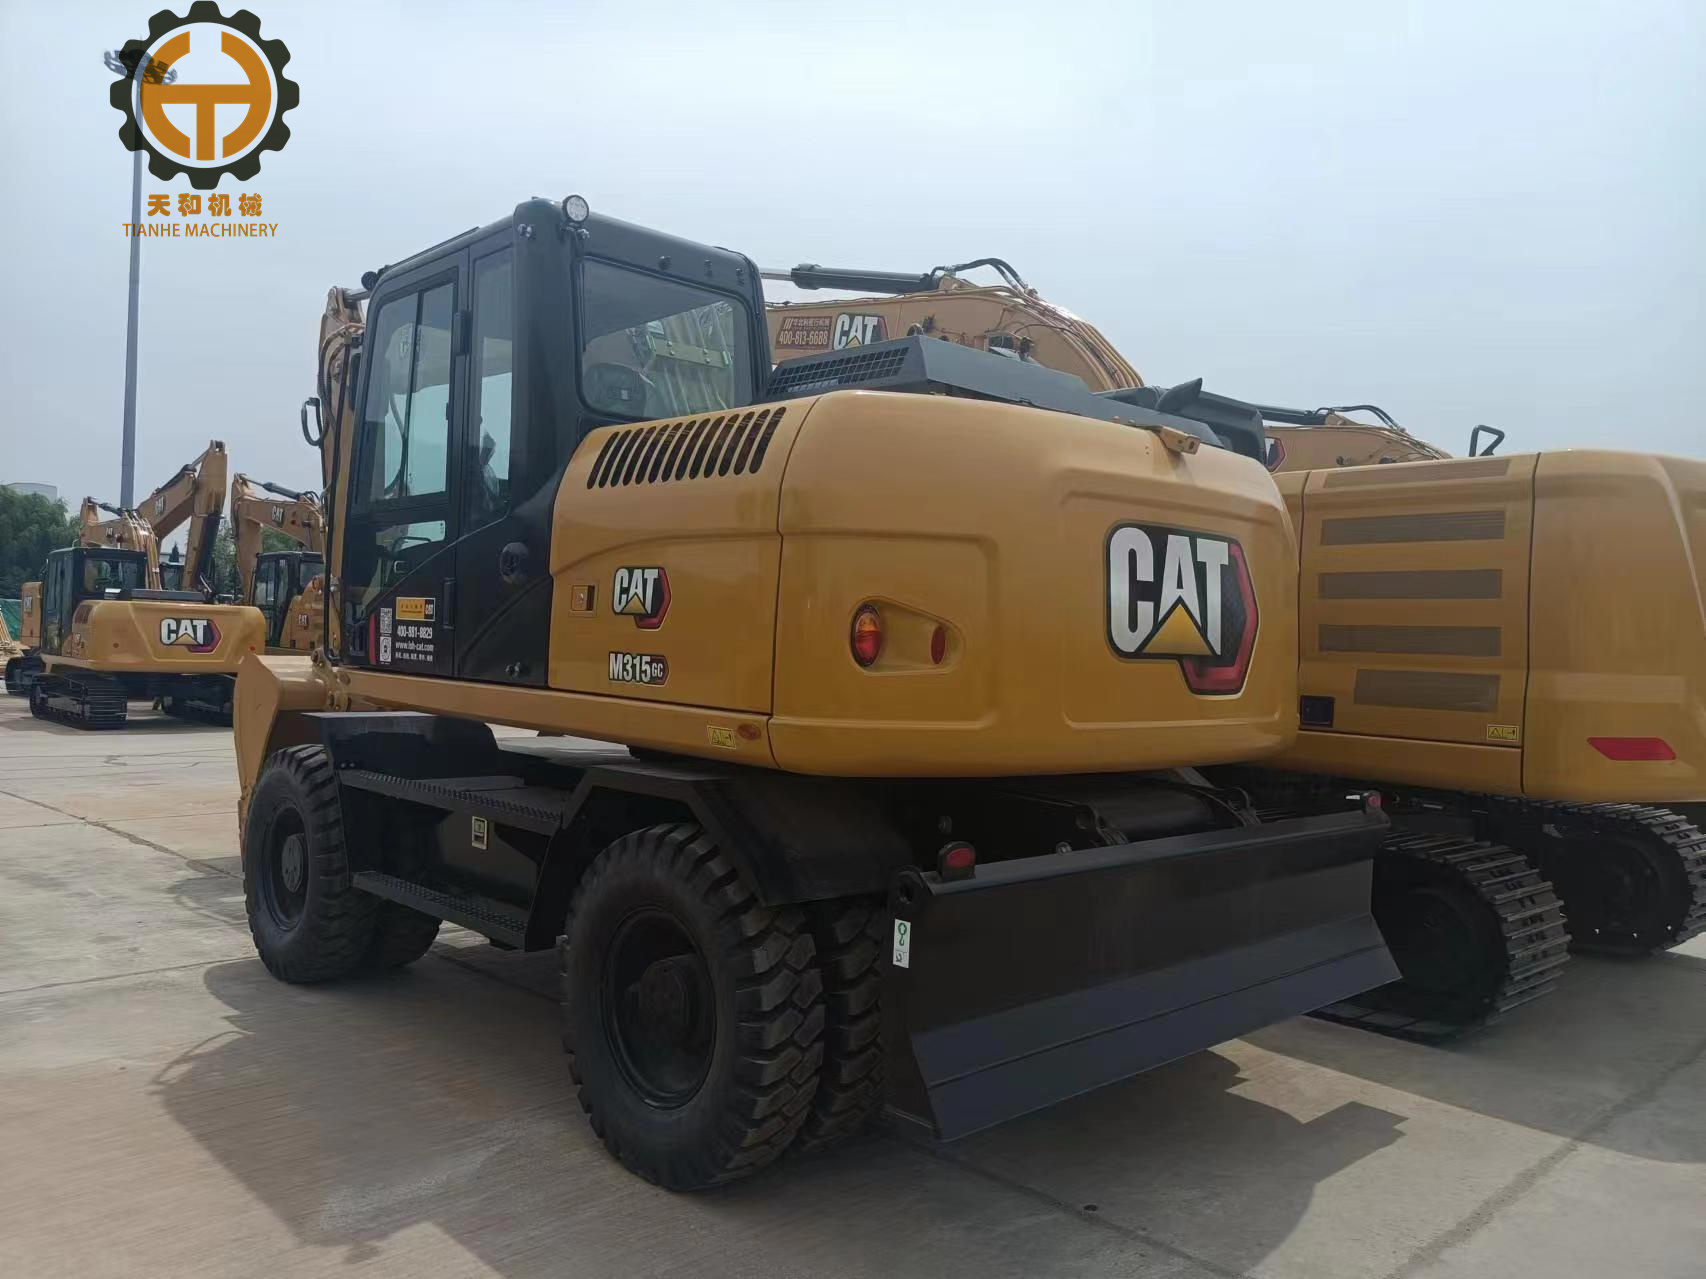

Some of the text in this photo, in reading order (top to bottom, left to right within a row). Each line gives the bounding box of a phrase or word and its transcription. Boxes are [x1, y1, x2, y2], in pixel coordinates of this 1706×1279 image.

[779, 331, 829, 345] 400-813-6688
[833, 313, 879, 350] CAT
[272, 505, 283, 523] CAT
[613, 568, 659, 615] CAT
[1109, 527, 1229, 656] CAT
[160, 618, 208, 645] CAT
[609, 653, 664, 682] M315 GC
